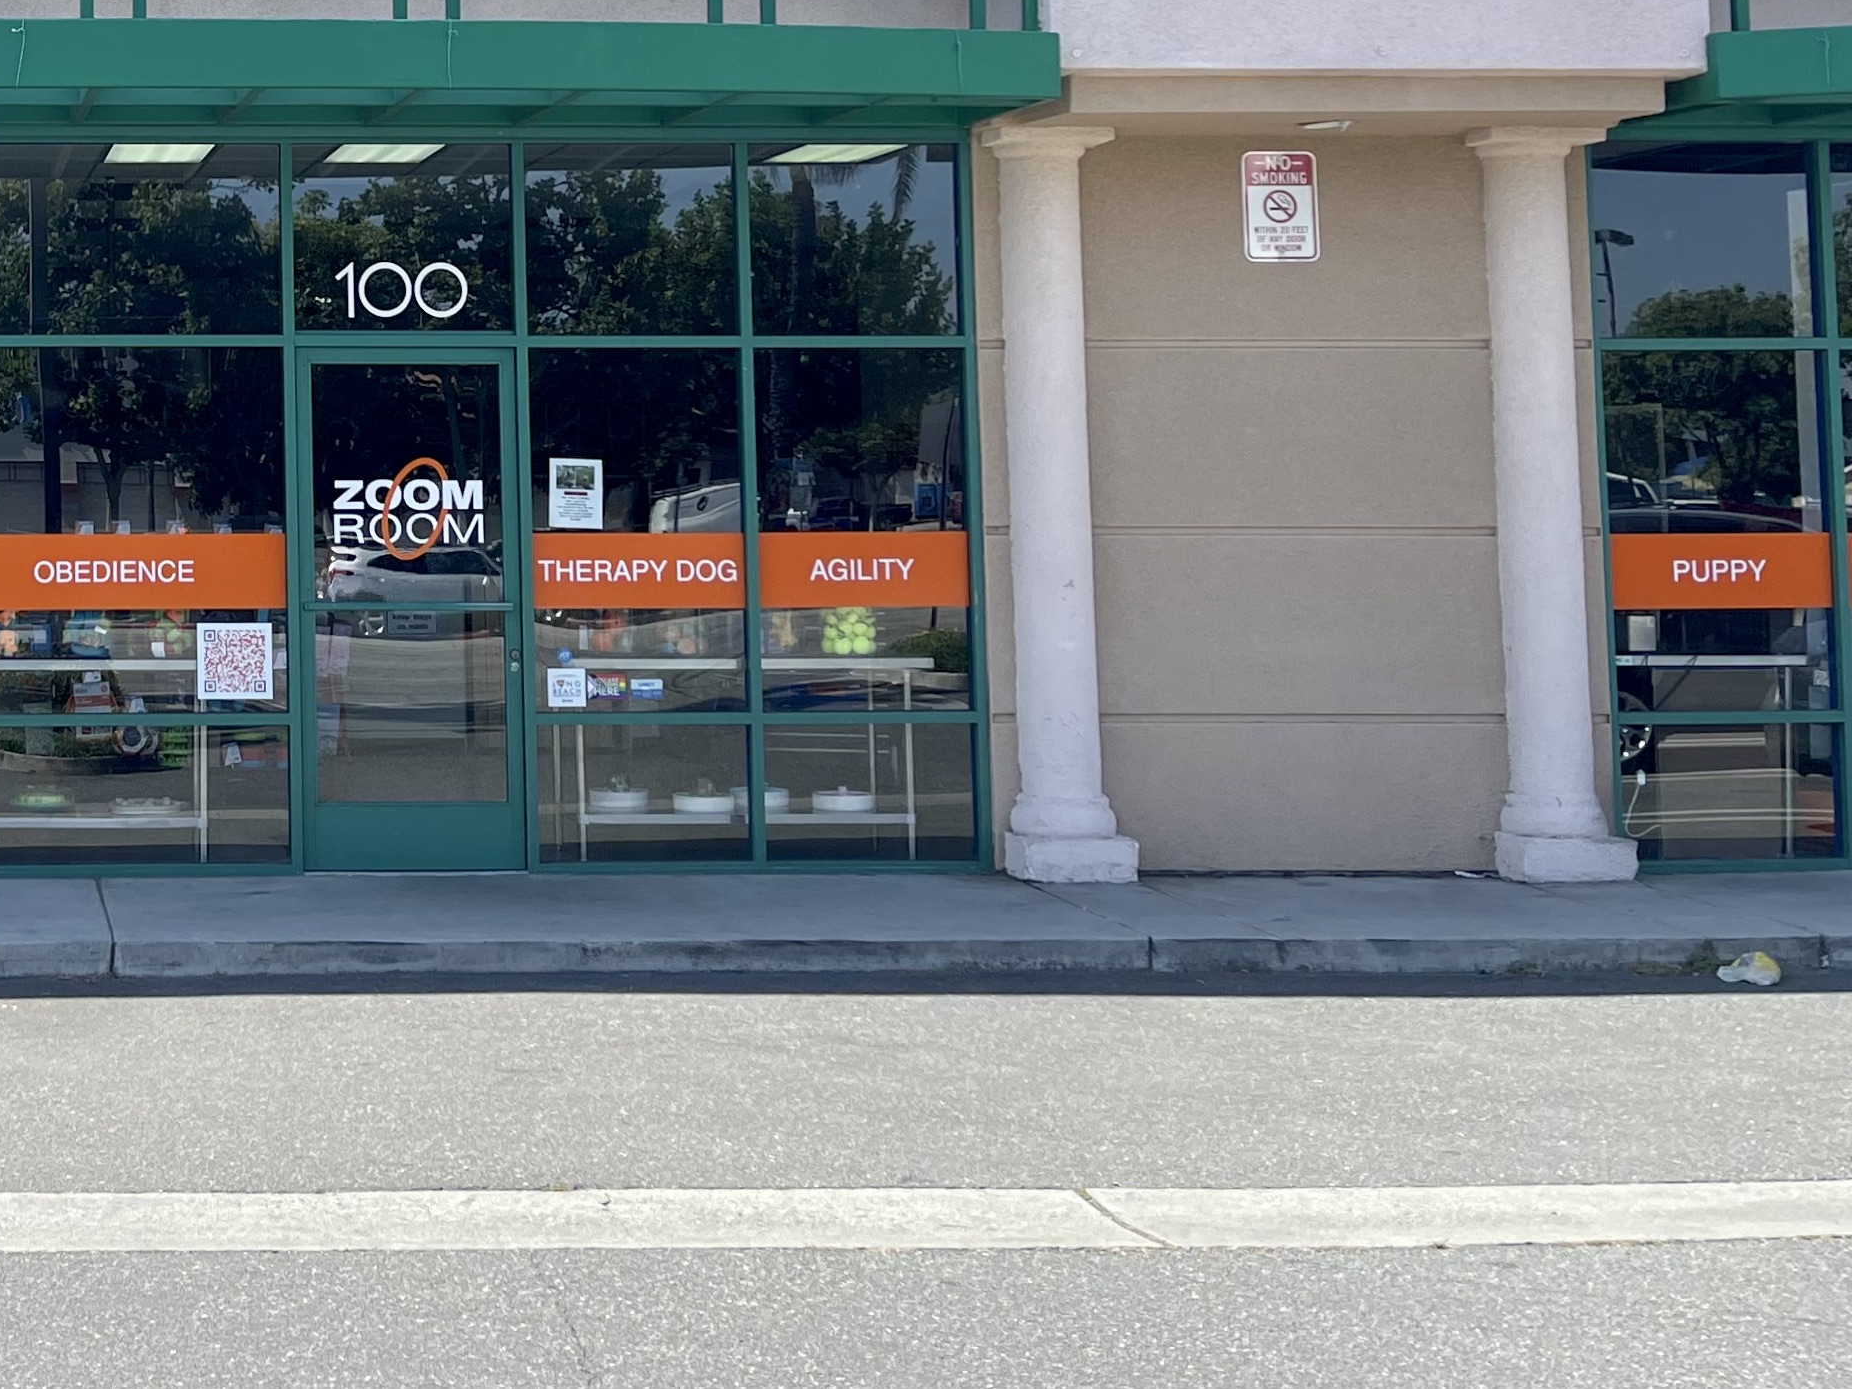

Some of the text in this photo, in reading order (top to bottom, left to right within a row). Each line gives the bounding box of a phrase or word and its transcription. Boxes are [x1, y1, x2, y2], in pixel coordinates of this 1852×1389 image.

[1265, 155, 1292, 171] NO
[1251, 172, 1308, 185] SMOKING
[335, 262, 468, 318] 100
[333, 479, 483, 511] ZOOM
[333, 513, 485, 545] ROOM
[33, 559, 195, 584] OBEDIENCE
[537, 558, 738, 583] THERAPY DOG
[809, 557, 914, 582] AGILITY
[1672, 559, 1767, 583] PUPPY
